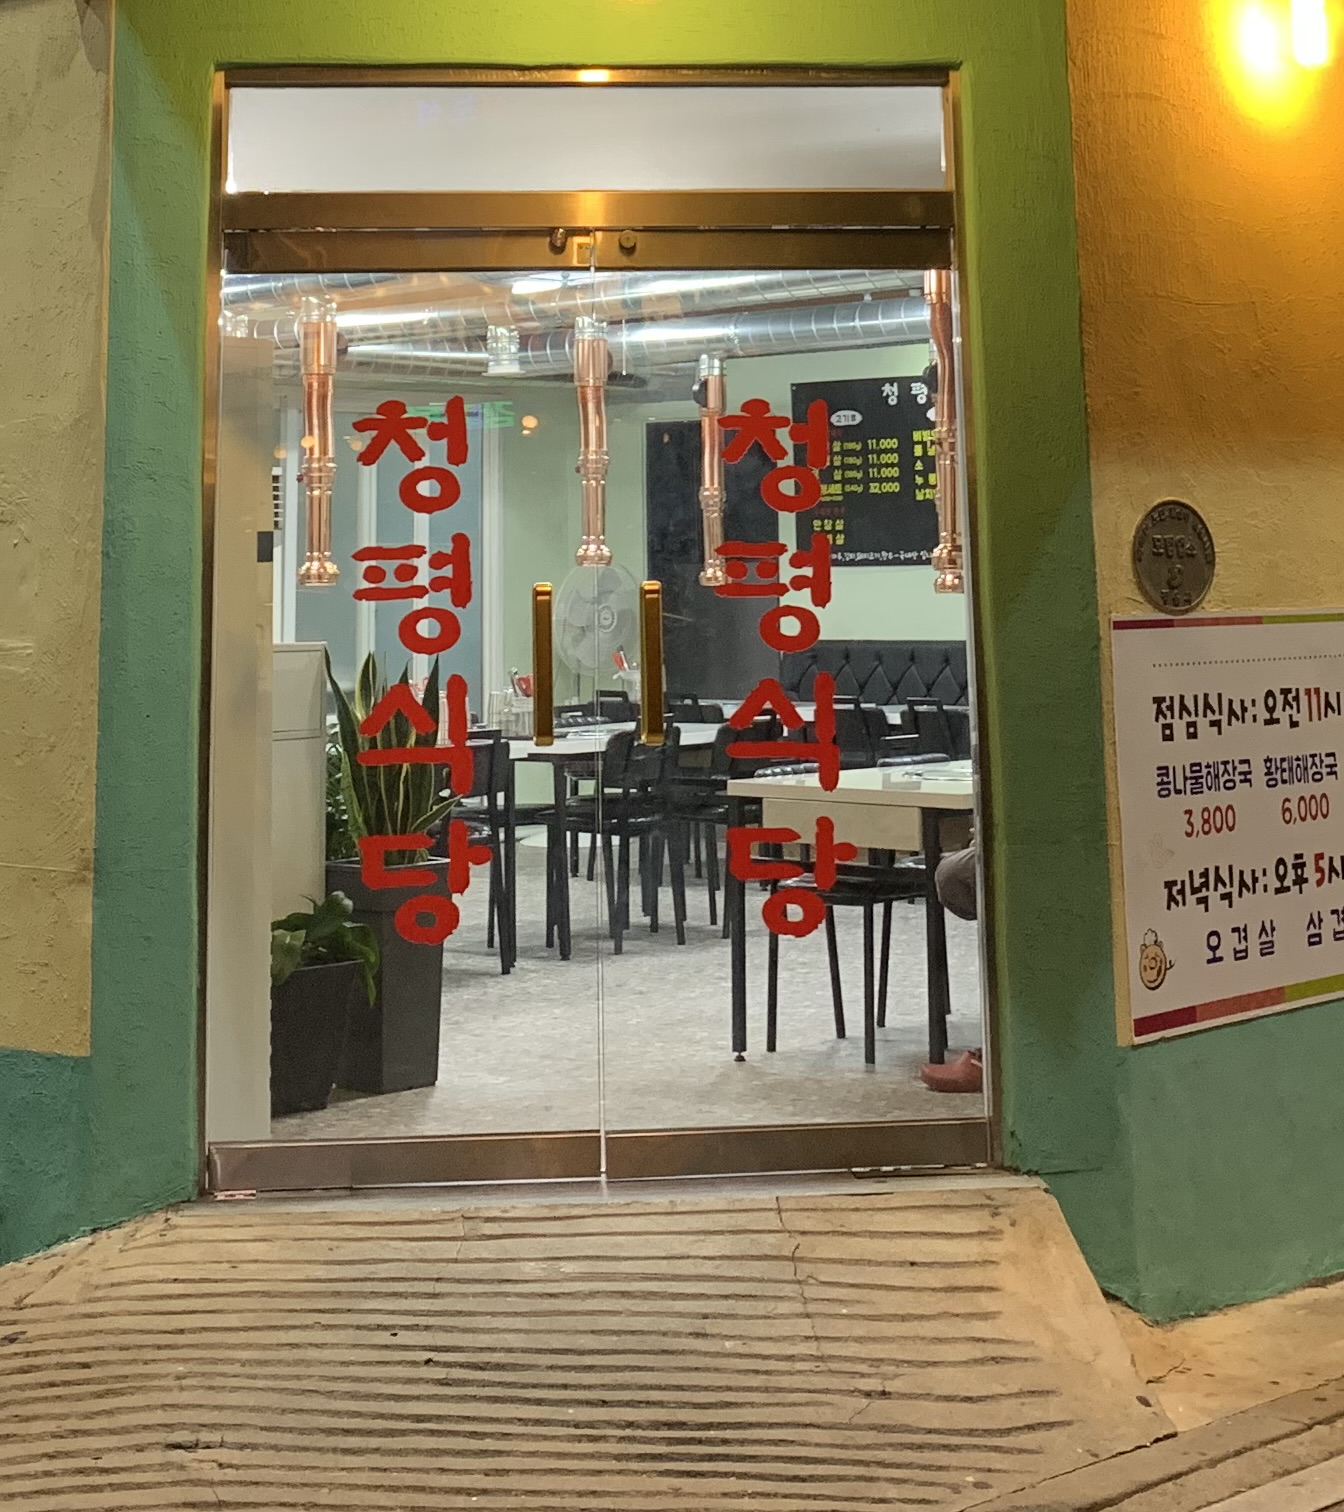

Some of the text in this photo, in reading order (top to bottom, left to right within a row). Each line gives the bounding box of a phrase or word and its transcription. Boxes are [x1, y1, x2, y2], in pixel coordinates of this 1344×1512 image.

[352, 395, 493, 945] 청평식당
[713, 397, 858, 937] 청평식당
[1156, 758, 1253, 800] 콩나물해장국
[1263, 751, 1339, 789] 황태해장국
[1183, 804, 1237, 838] 3,800
[1280, 793, 1331, 826] 6,000
[1205, 918, 1276, 965] 오겹살
